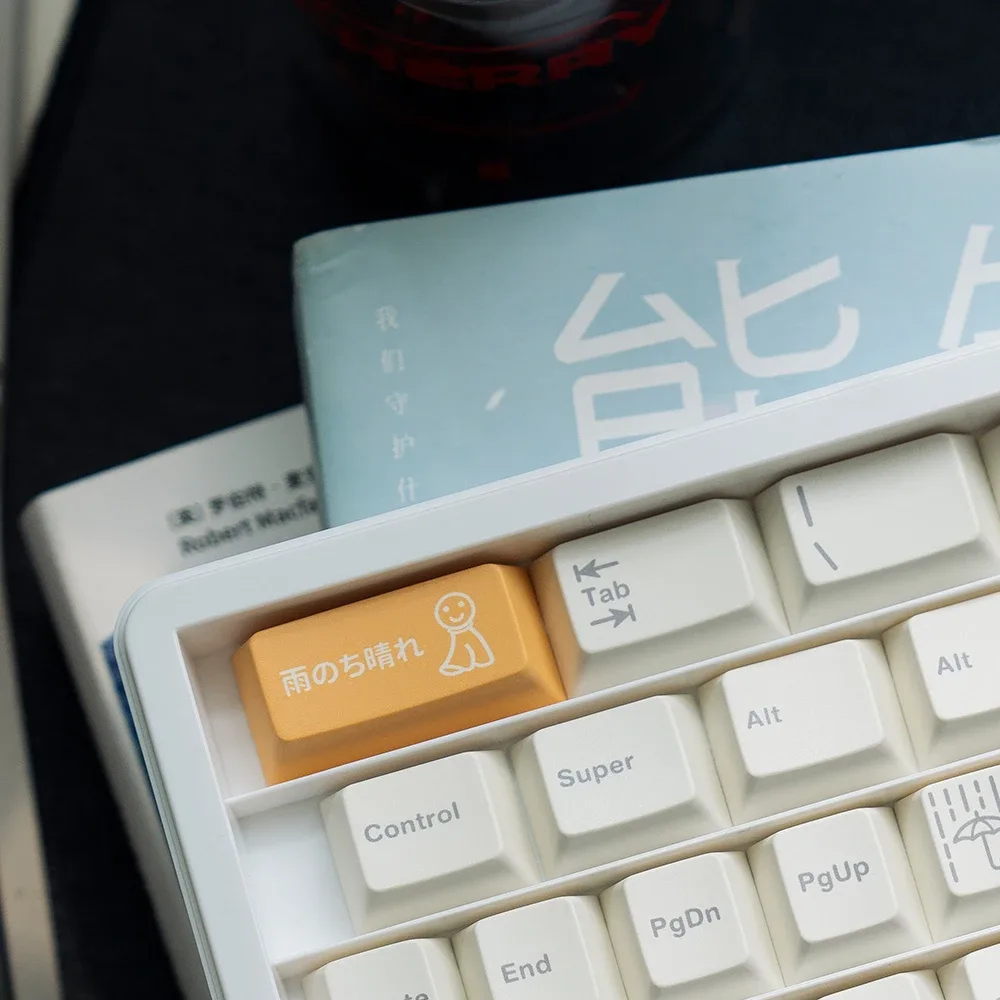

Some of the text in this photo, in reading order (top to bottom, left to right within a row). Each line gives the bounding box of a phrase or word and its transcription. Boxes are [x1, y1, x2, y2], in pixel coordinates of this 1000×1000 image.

[580, 579, 632, 608] Tab
[279, 637, 424, 697] 雨のち晴れ
[937, 651, 974, 676] Alt
[747, 706, 783, 730] Alt
[556, 754, 635, 788] Super
[363, 801, 461, 843] Control
[797, 860, 870, 893] PgUp
[649, 906, 722, 939] PgDn
[500, 953, 553, 985] End
